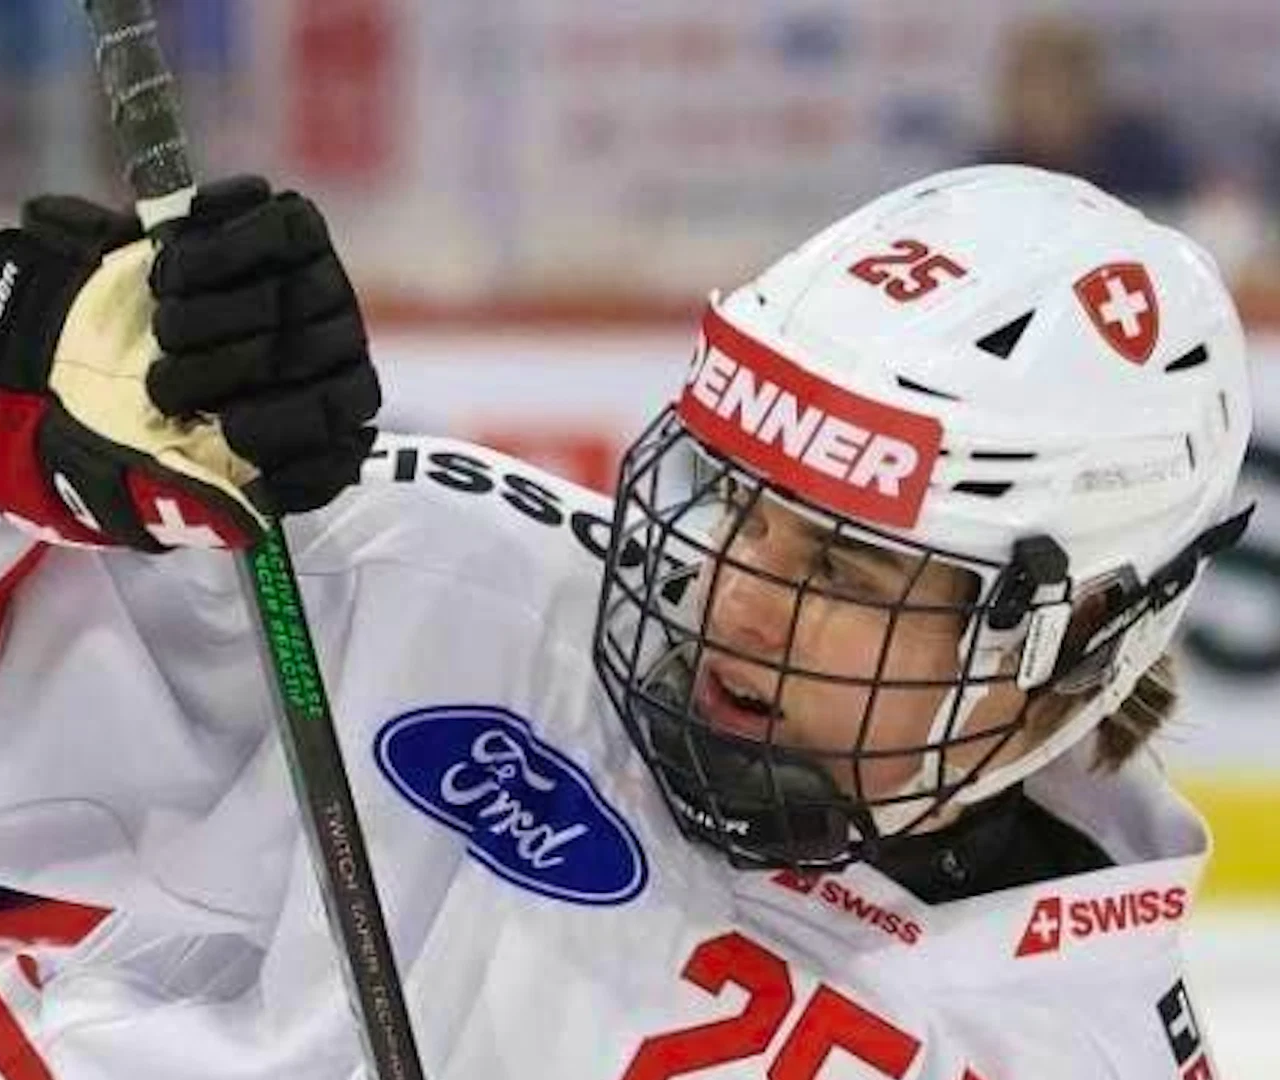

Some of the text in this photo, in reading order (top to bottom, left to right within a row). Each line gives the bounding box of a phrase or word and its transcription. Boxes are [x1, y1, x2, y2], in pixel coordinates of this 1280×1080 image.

[847, 240, 968, 303] 25
[439, 729, 591, 870] Ford
[820, 878, 921, 946] SWISS
[1069, 887, 1187, 938] SWISS
